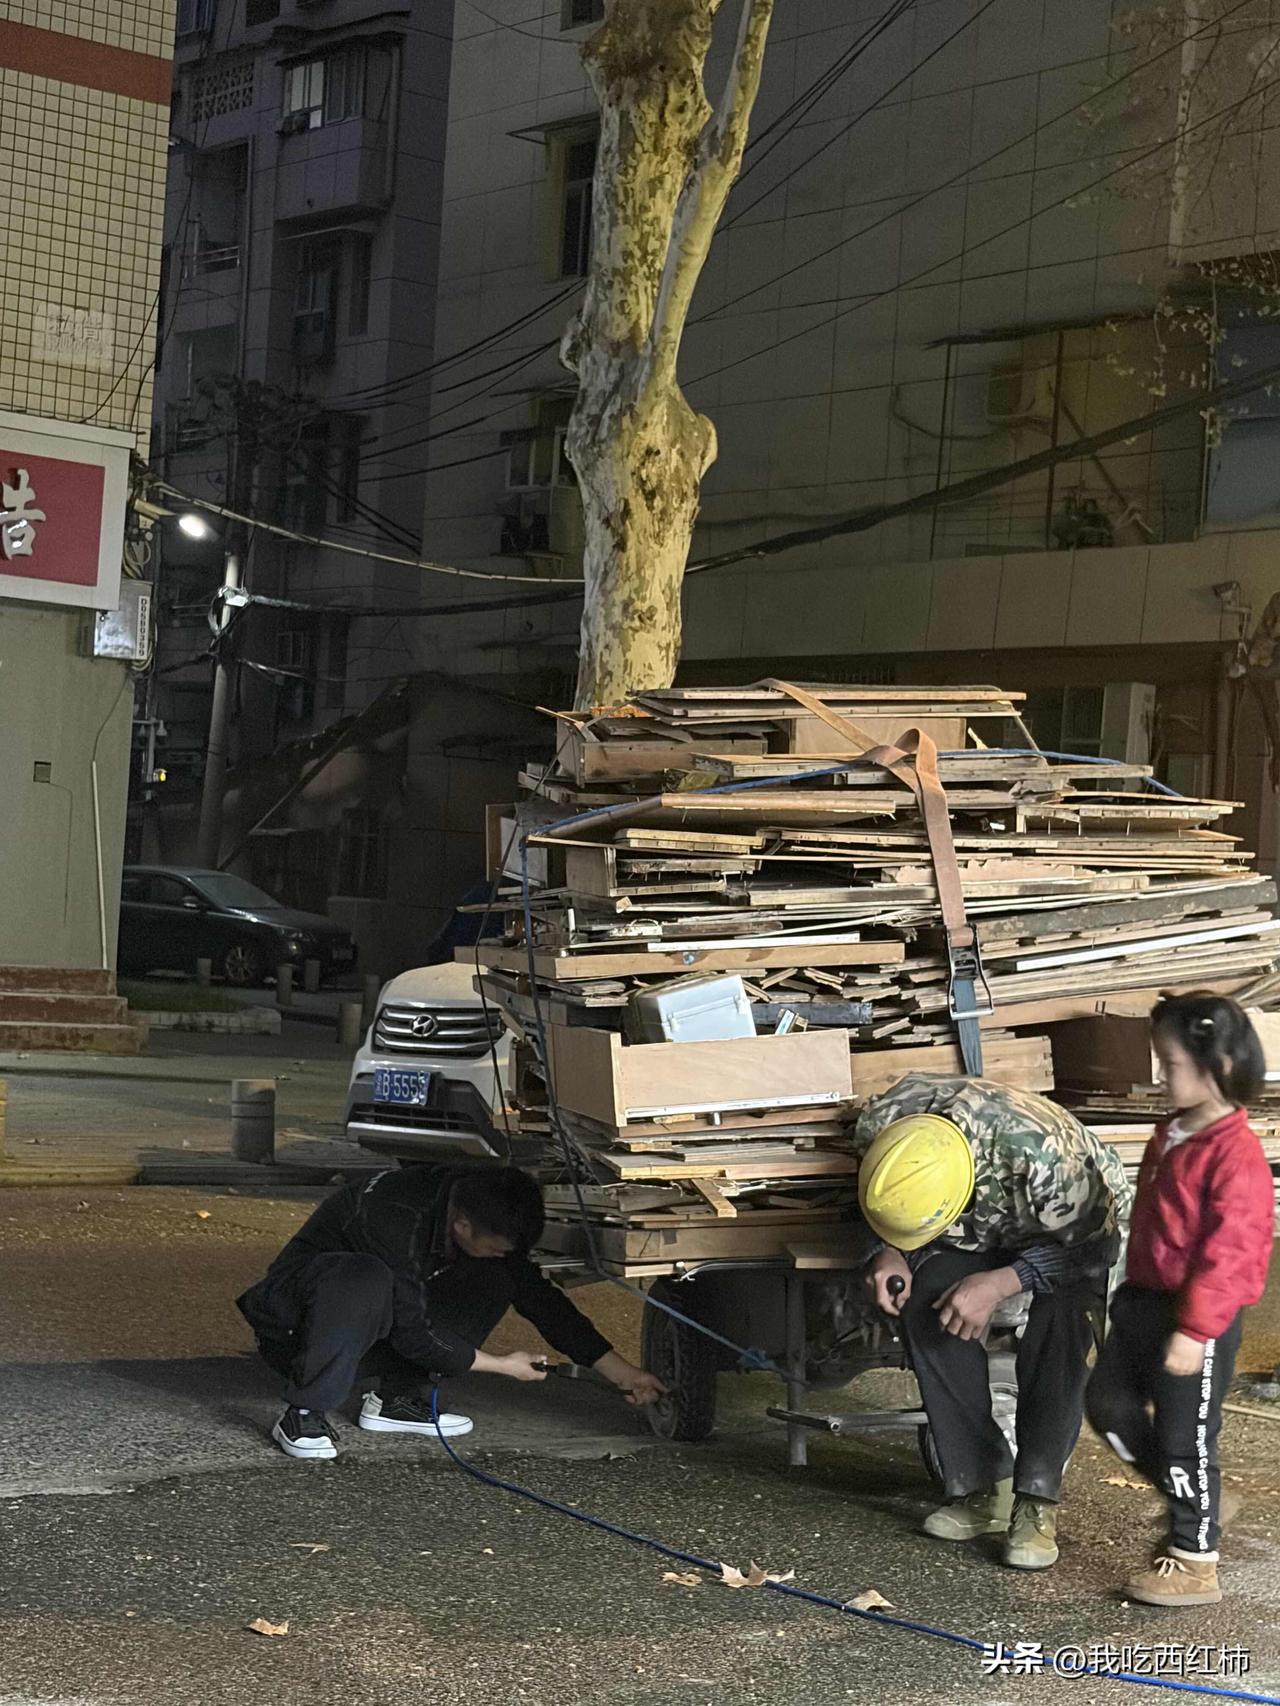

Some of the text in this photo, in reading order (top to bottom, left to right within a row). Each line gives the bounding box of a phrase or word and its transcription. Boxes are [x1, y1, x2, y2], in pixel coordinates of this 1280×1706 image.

[1203, 1358, 1214, 1377] CAN
[1201, 1377, 1212, 1401] STOP
[1198, 1400, 1209, 1420] YOU
[1196, 1468, 1209, 1492] STOP
[1199, 1490, 1211, 1510] YOU
